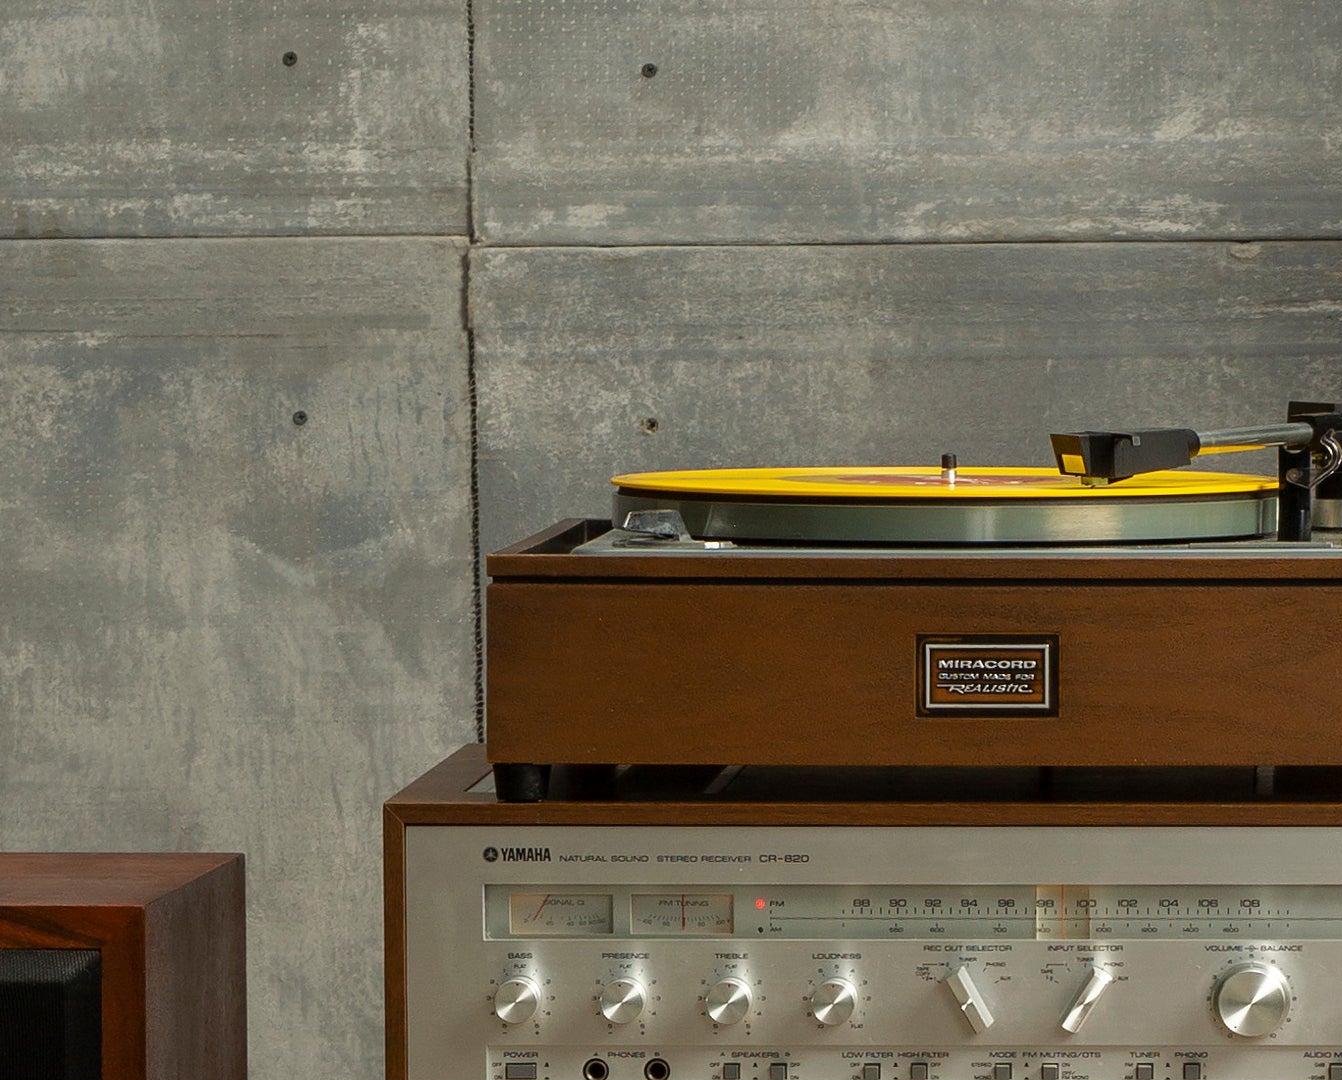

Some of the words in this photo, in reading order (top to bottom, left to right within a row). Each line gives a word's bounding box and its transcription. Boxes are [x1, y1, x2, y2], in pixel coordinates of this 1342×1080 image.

[938, 659, 1037, 669] MIRACORD
[936, 683, 1033, 694] REALISTIC
[501, 847, 552, 862] YAMAHA
[559, 855, 607, 863] NATURAL
[611, 855, 649, 863] SOUND
[656, 855, 698, 863] STEREO
[701, 855, 752, 863] RECEIVER
[759, 854, 810, 863] CR-820
[853, 899, 871, 908] 88
[889, 899, 907, 908] 90
[924, 899, 941, 908] 92
[960, 899, 977, 908] 94
[997, 899, 1015, 908] 96
[1037, 899, 1054, 908] 98
[1076, 899, 1096, 908] 100
[1118, 899, 1138, 908] 102
[1159, 899, 1179, 908] 104
[1198, 899, 1218, 908] 106
[1240, 899, 1260, 908] 108
[602, 952, 650, 960] PRESENCE
